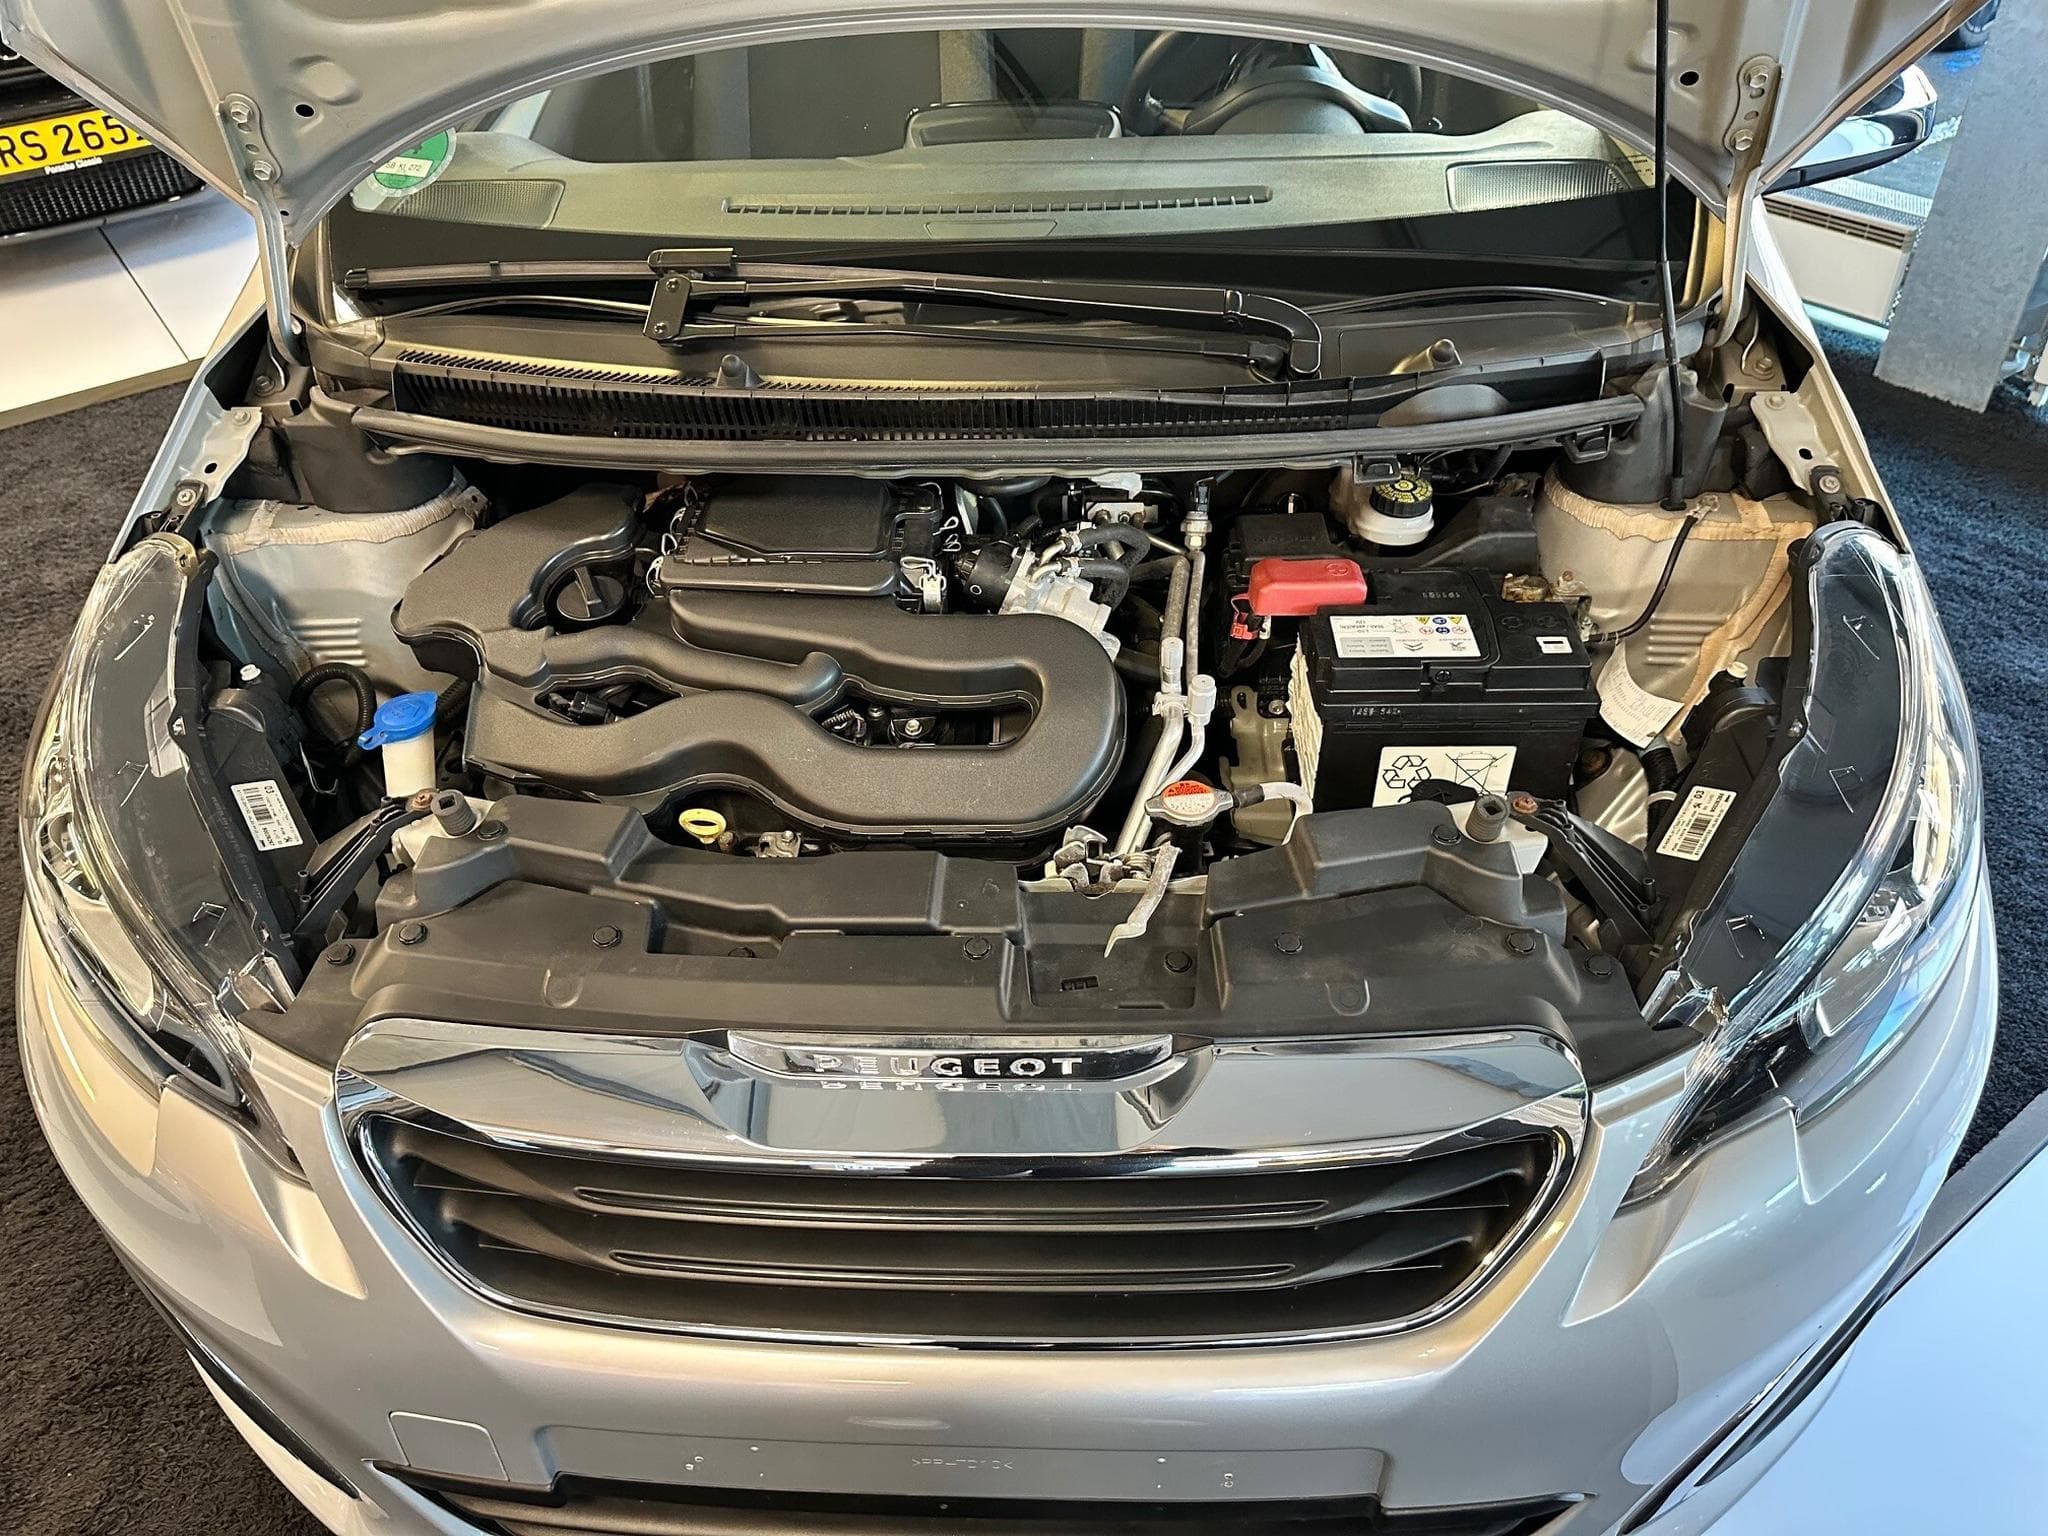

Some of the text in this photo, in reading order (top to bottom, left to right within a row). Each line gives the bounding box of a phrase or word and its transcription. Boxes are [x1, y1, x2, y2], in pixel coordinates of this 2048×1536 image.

[52, 115, 144, 156] 265
[1694, 790, 1705, 799] 03
[812, 1054, 1083, 1076] PEUGEOT
